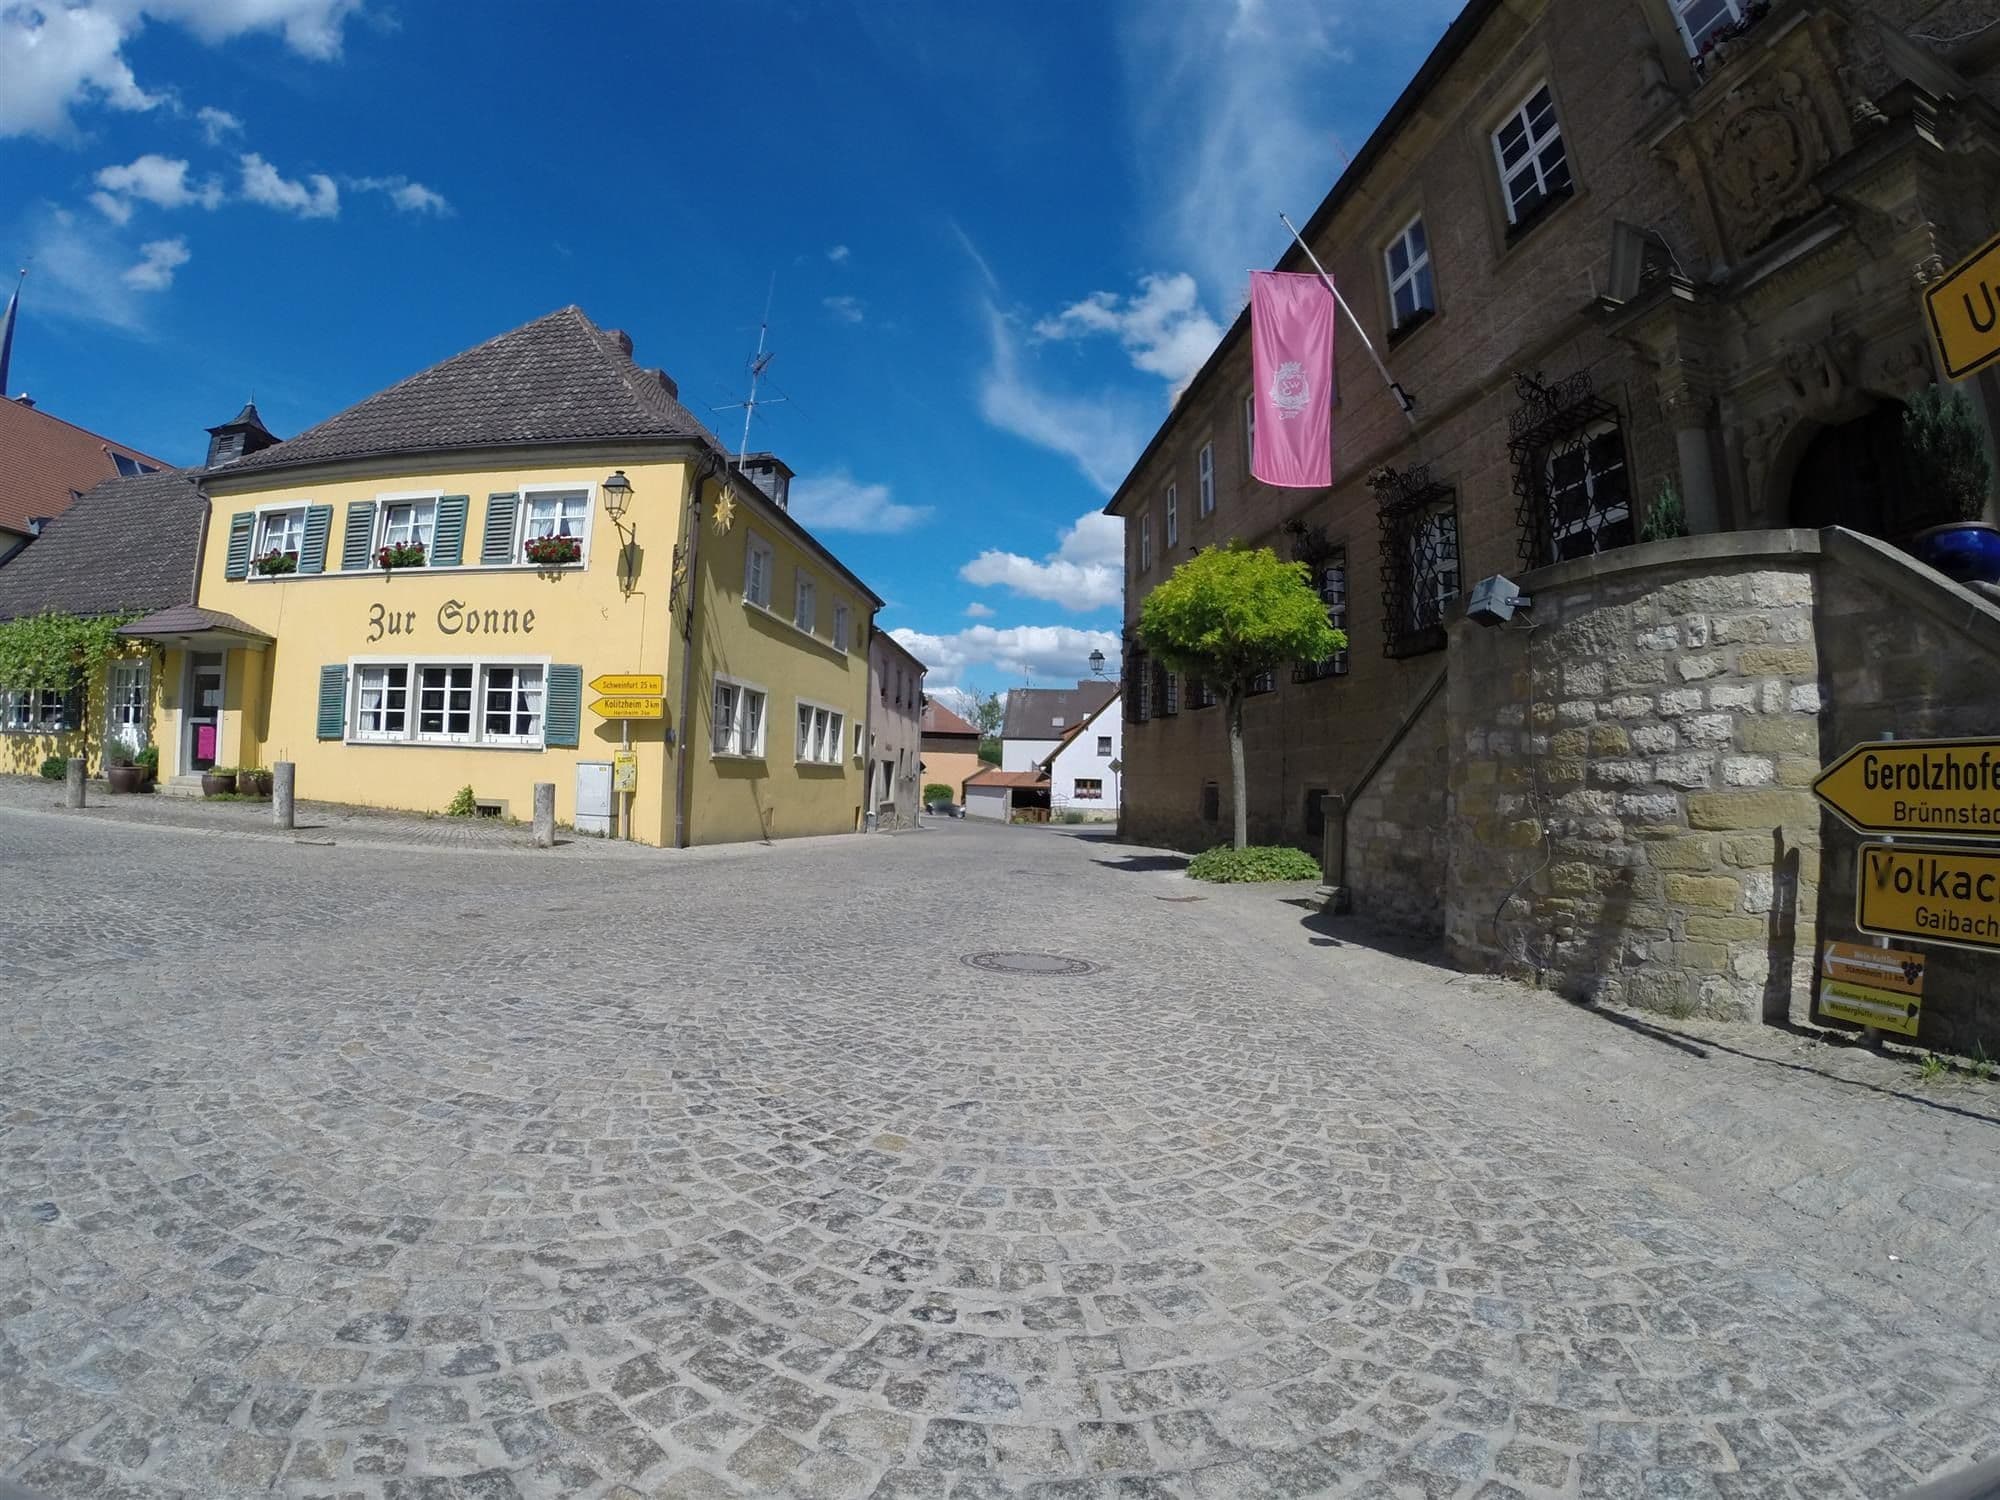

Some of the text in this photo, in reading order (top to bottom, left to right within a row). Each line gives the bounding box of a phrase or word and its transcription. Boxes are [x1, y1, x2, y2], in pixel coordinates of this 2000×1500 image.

[367, 599, 536, 643] Zur Sonne
[602, 680, 638, 689] Schweinfurt
[604, 699, 660, 709] Kolitzheim 3 km
[1915, 907, 1998, 937] Gaibach
